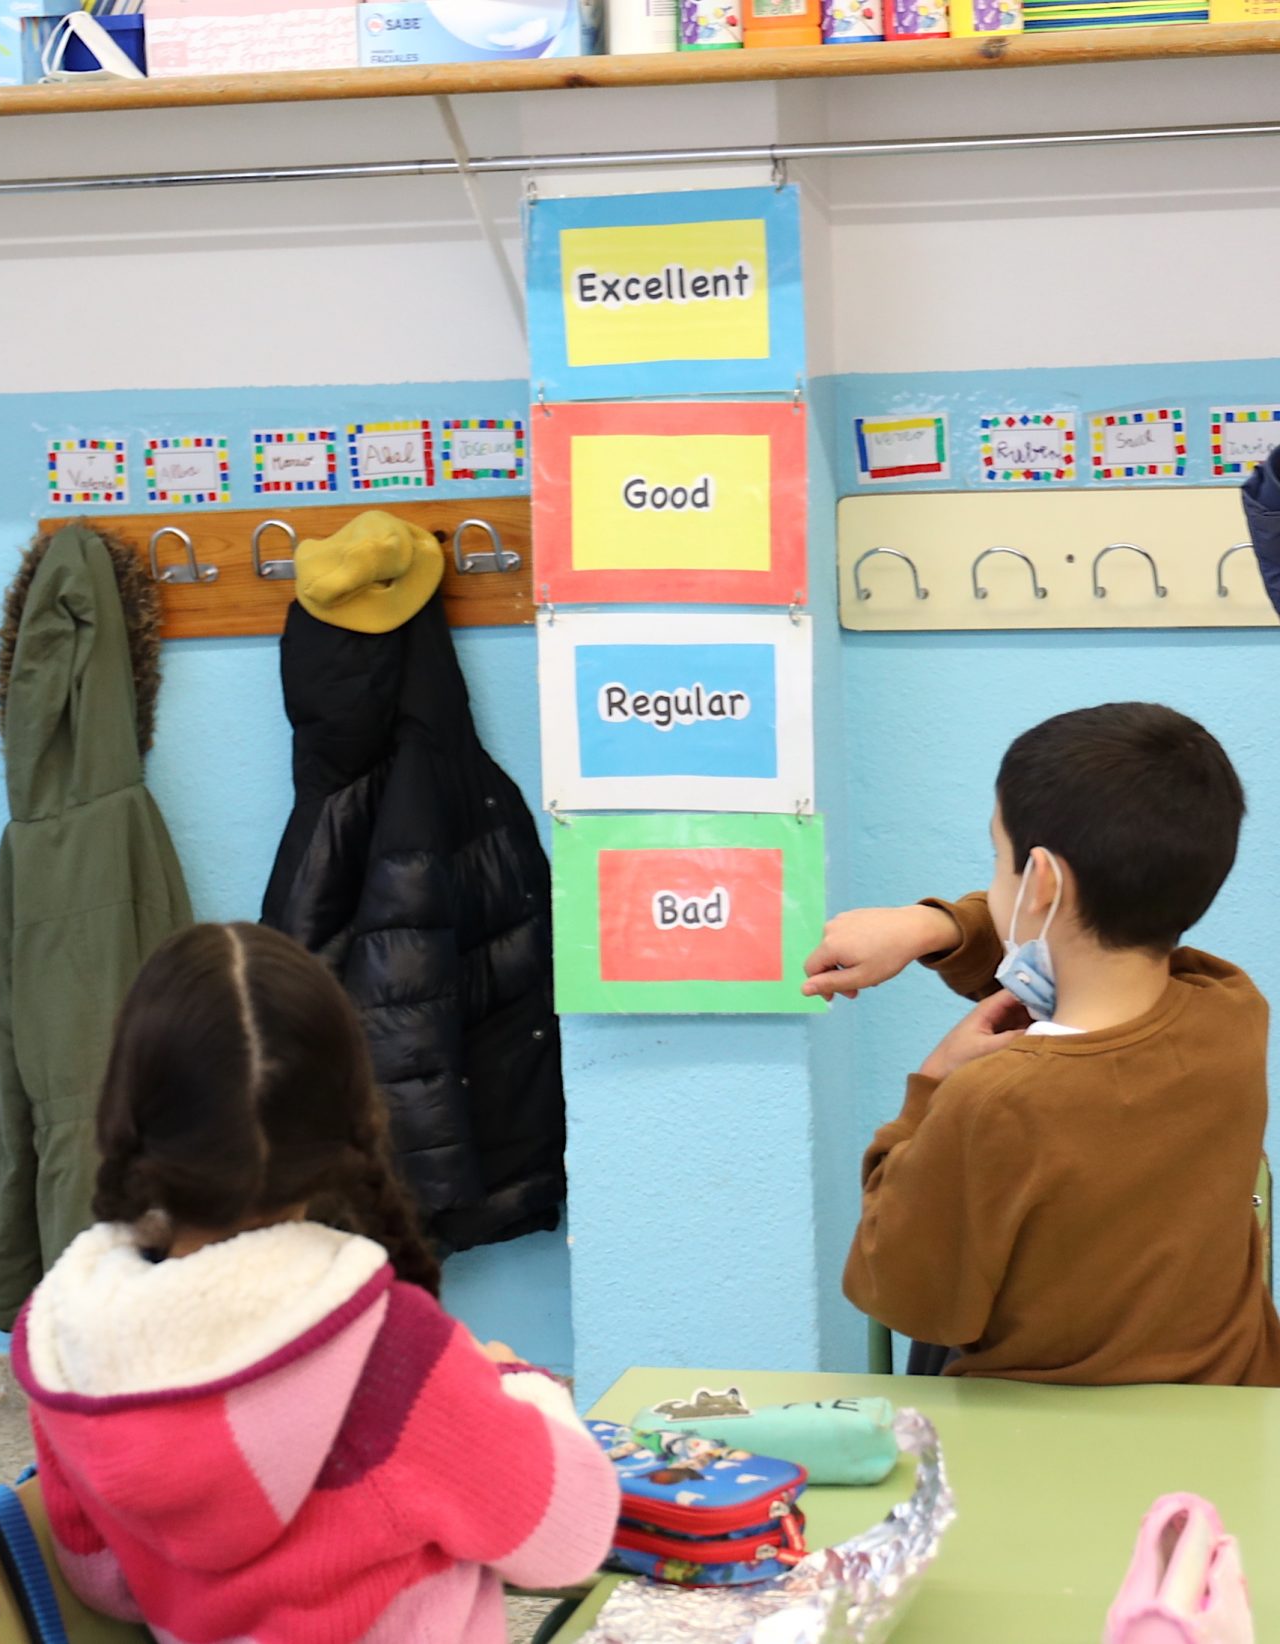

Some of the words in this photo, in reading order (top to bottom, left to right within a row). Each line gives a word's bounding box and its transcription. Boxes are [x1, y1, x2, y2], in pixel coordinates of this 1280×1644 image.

[385, 17, 421, 31] SABE
[577, 264, 750, 303] Excellent
[624, 477, 710, 509] Good
[606, 685, 745, 727] Regular
[658, 892, 723, 925] Bad
